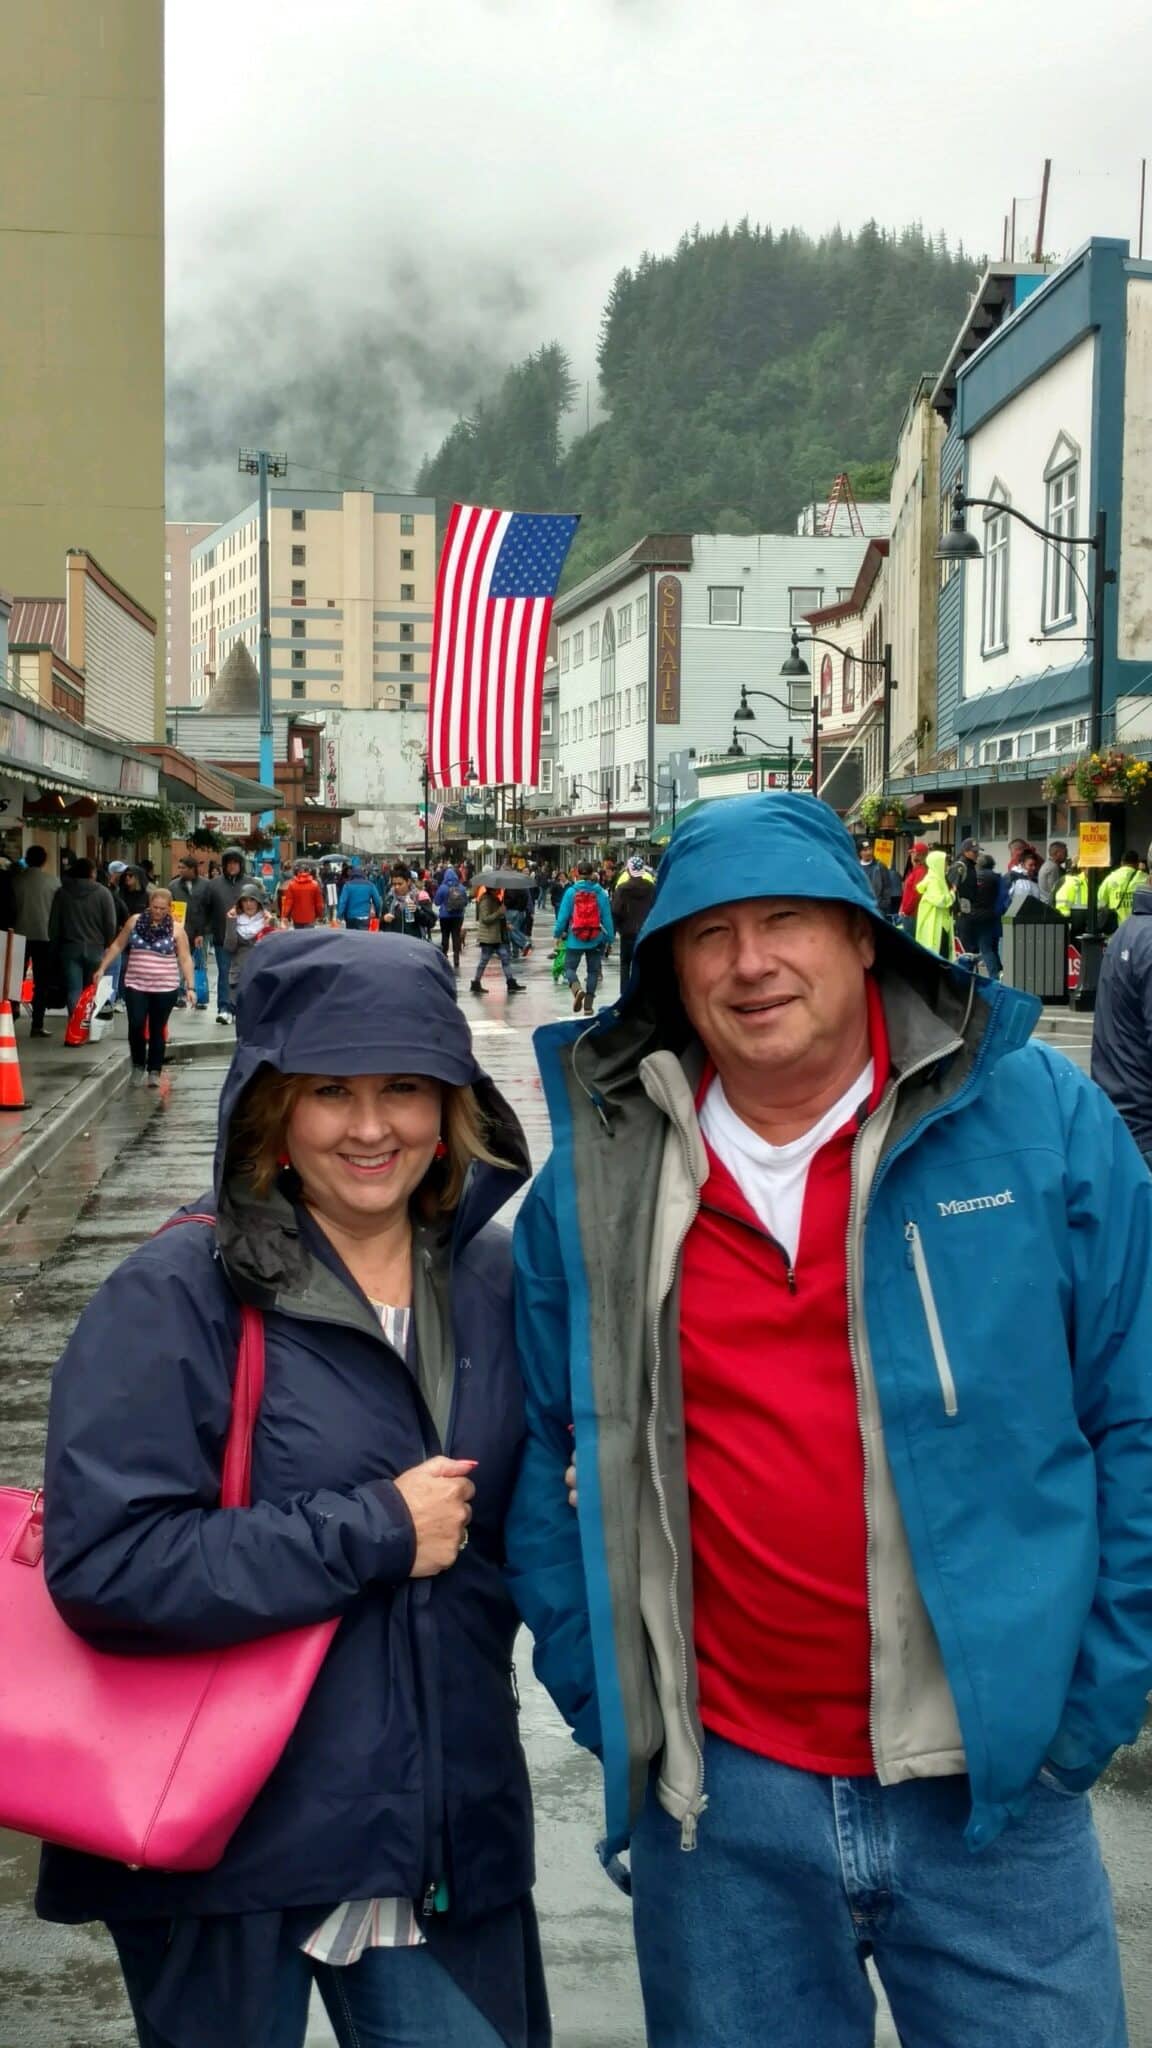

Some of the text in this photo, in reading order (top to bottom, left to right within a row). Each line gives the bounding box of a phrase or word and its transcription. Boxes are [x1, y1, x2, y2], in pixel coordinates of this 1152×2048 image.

[660, 587, 678, 711] SENATE
[222, 815, 245, 823] TAKU
[1090, 824, 1099, 833] NO
[1081, 833, 1108, 843] PARKING
[936, 1189, 1016, 1217] Marmot
